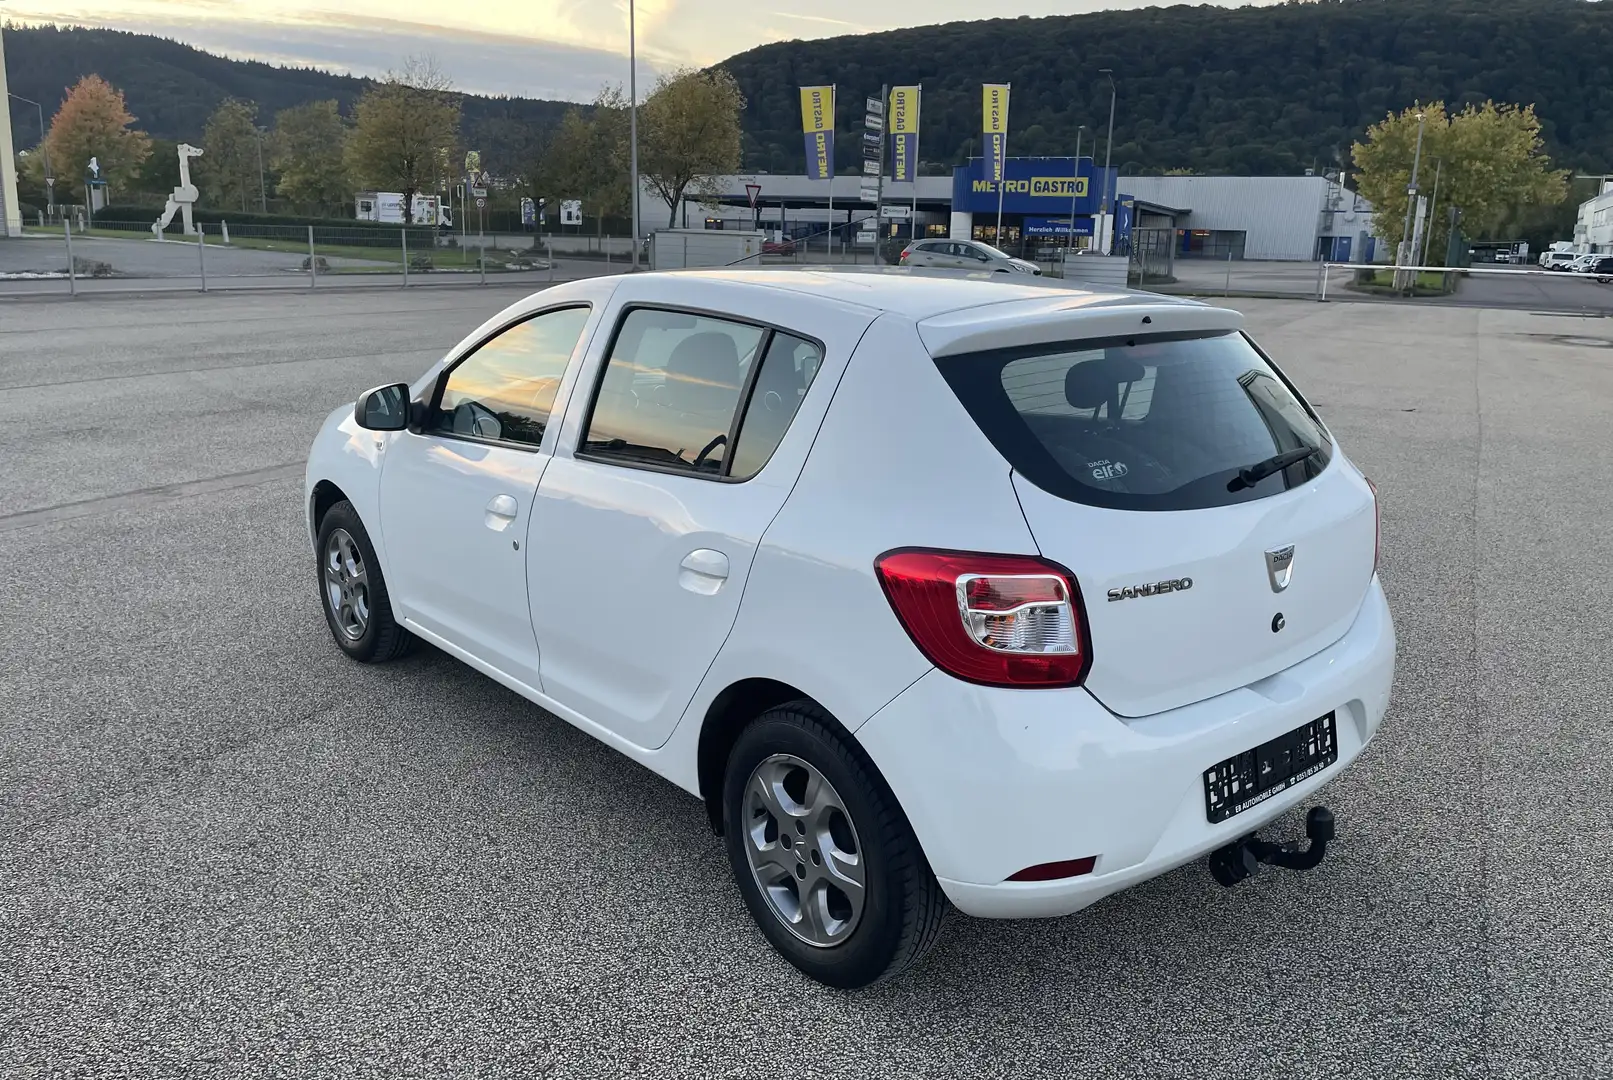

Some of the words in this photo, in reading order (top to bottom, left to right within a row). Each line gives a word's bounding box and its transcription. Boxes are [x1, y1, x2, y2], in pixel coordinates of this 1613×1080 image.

[1034, 180, 1084, 193] GASTRO
[1088, 459, 1111, 468] DACIA
[1092, 464, 1114, 481] elf
[1273, 552, 1293, 563] DACIA
[1107, 576, 1194, 602] SANDERO
[1235, 805, 1242, 814] EB
[1242, 789, 1272, 810] AUTOMOBILE
